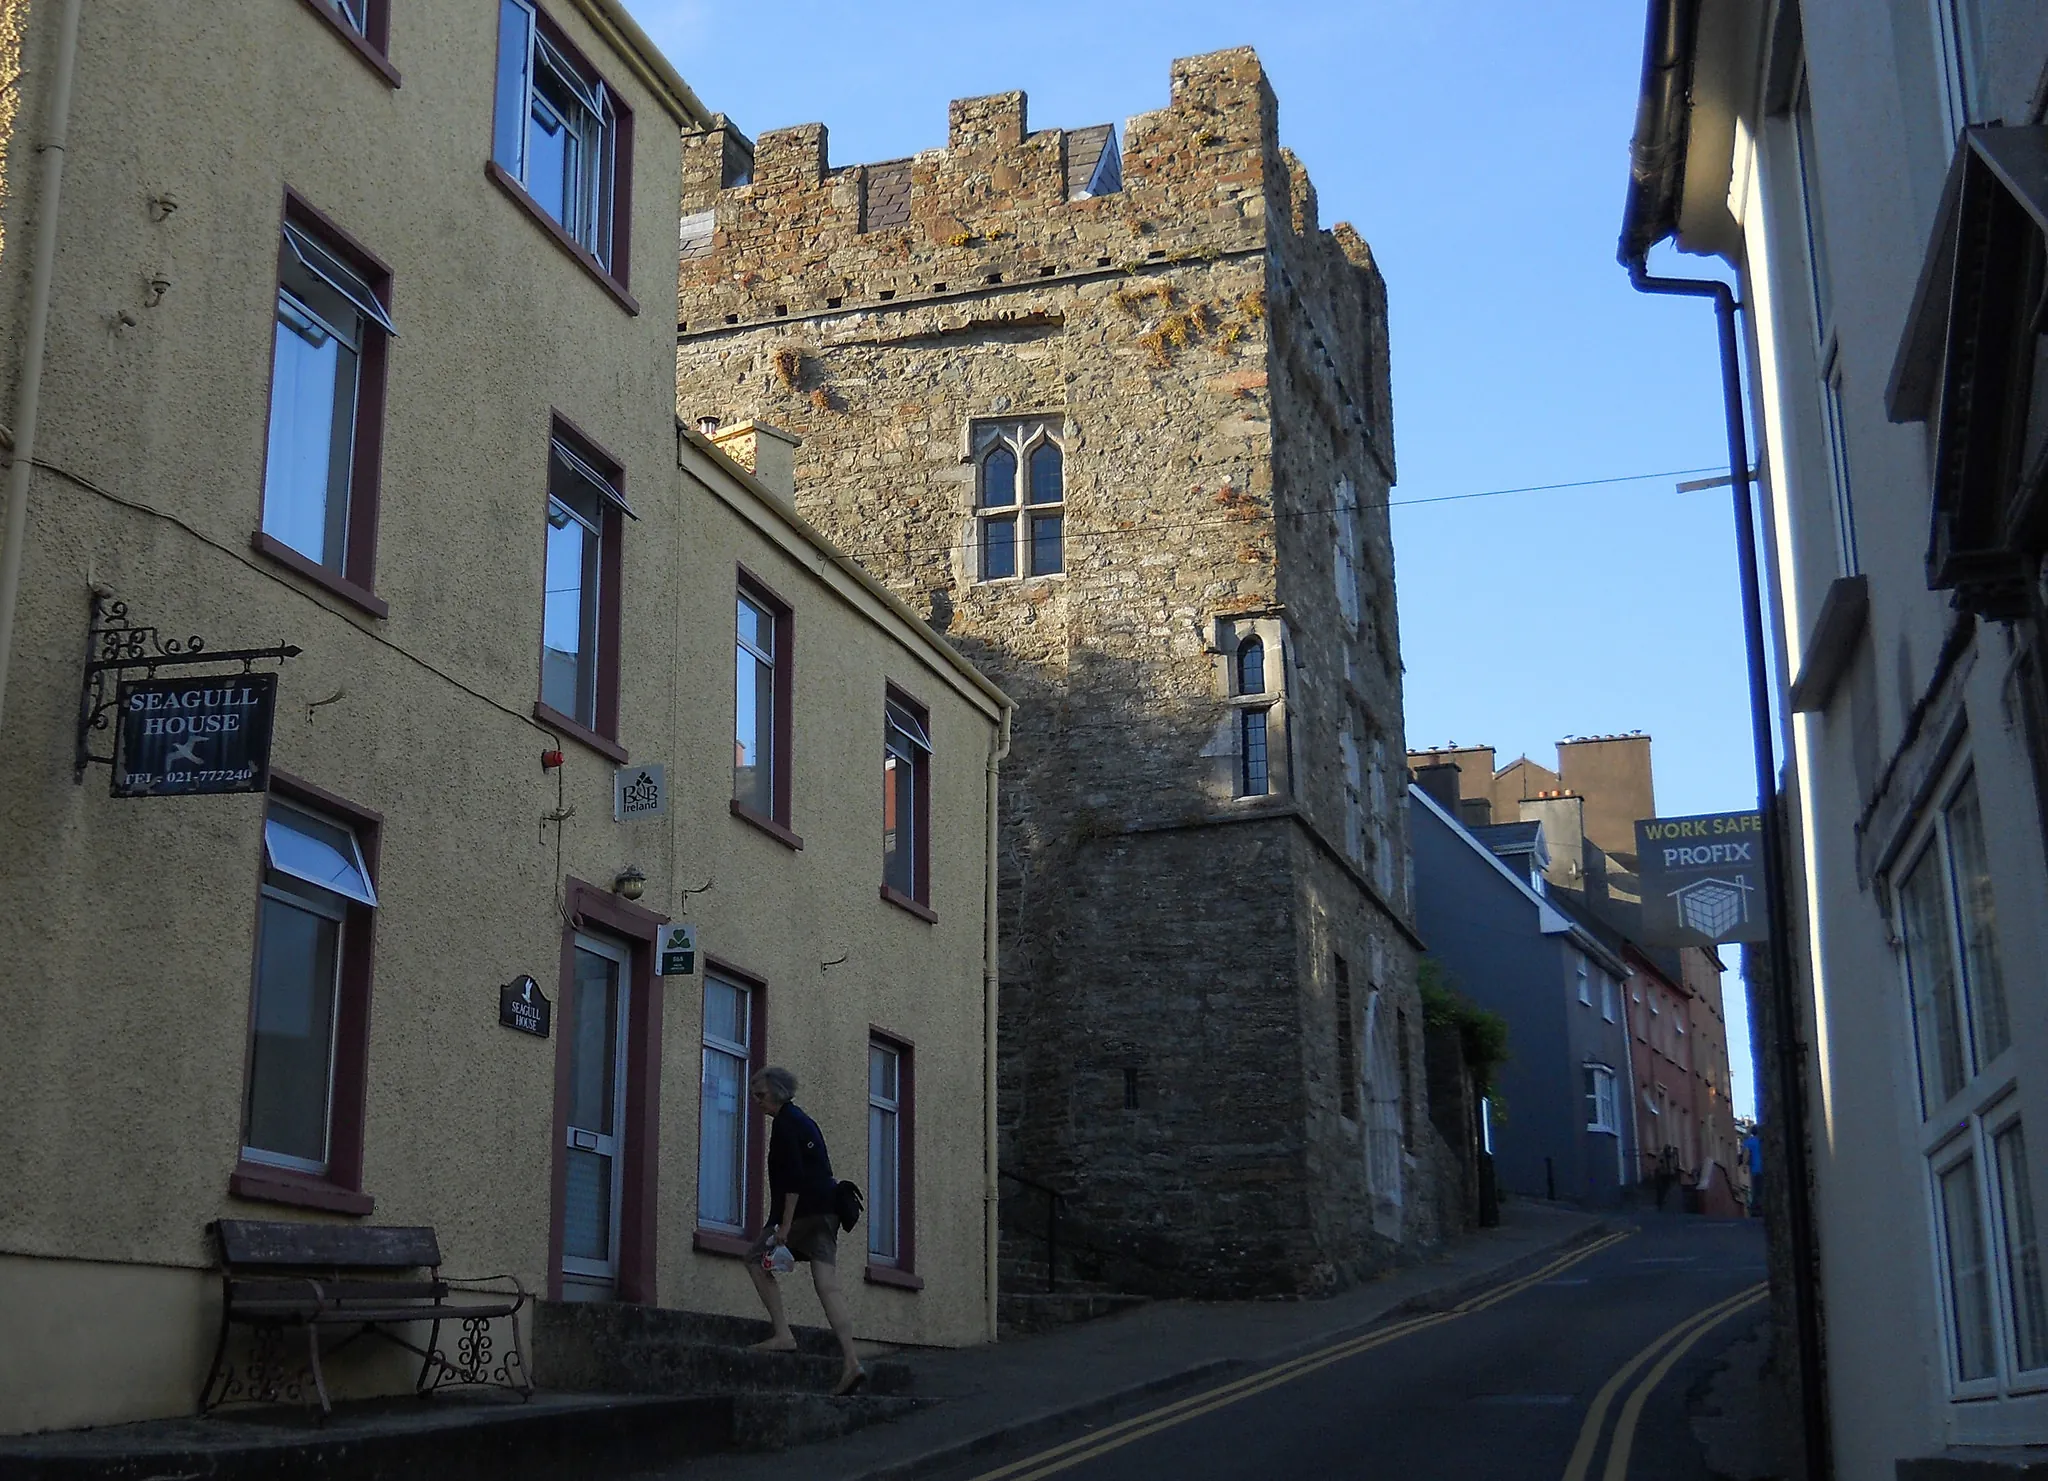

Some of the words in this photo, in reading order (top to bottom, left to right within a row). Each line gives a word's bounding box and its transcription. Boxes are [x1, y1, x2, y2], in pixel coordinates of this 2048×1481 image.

[129, 688, 258, 712] SEAGULL
[143, 713, 240, 735] HOUSE
[623, 785, 657, 804] B&B
[623, 799, 657, 812] Ireland
[1645, 820, 1707, 840] WORK
[1713, 816, 1761, 834] SAFE
[1663, 842, 1751, 866] PROFIX
[511, 1001, 540, 1020] SEAGULL
[515, 1014, 537, 1031] HOUSE
